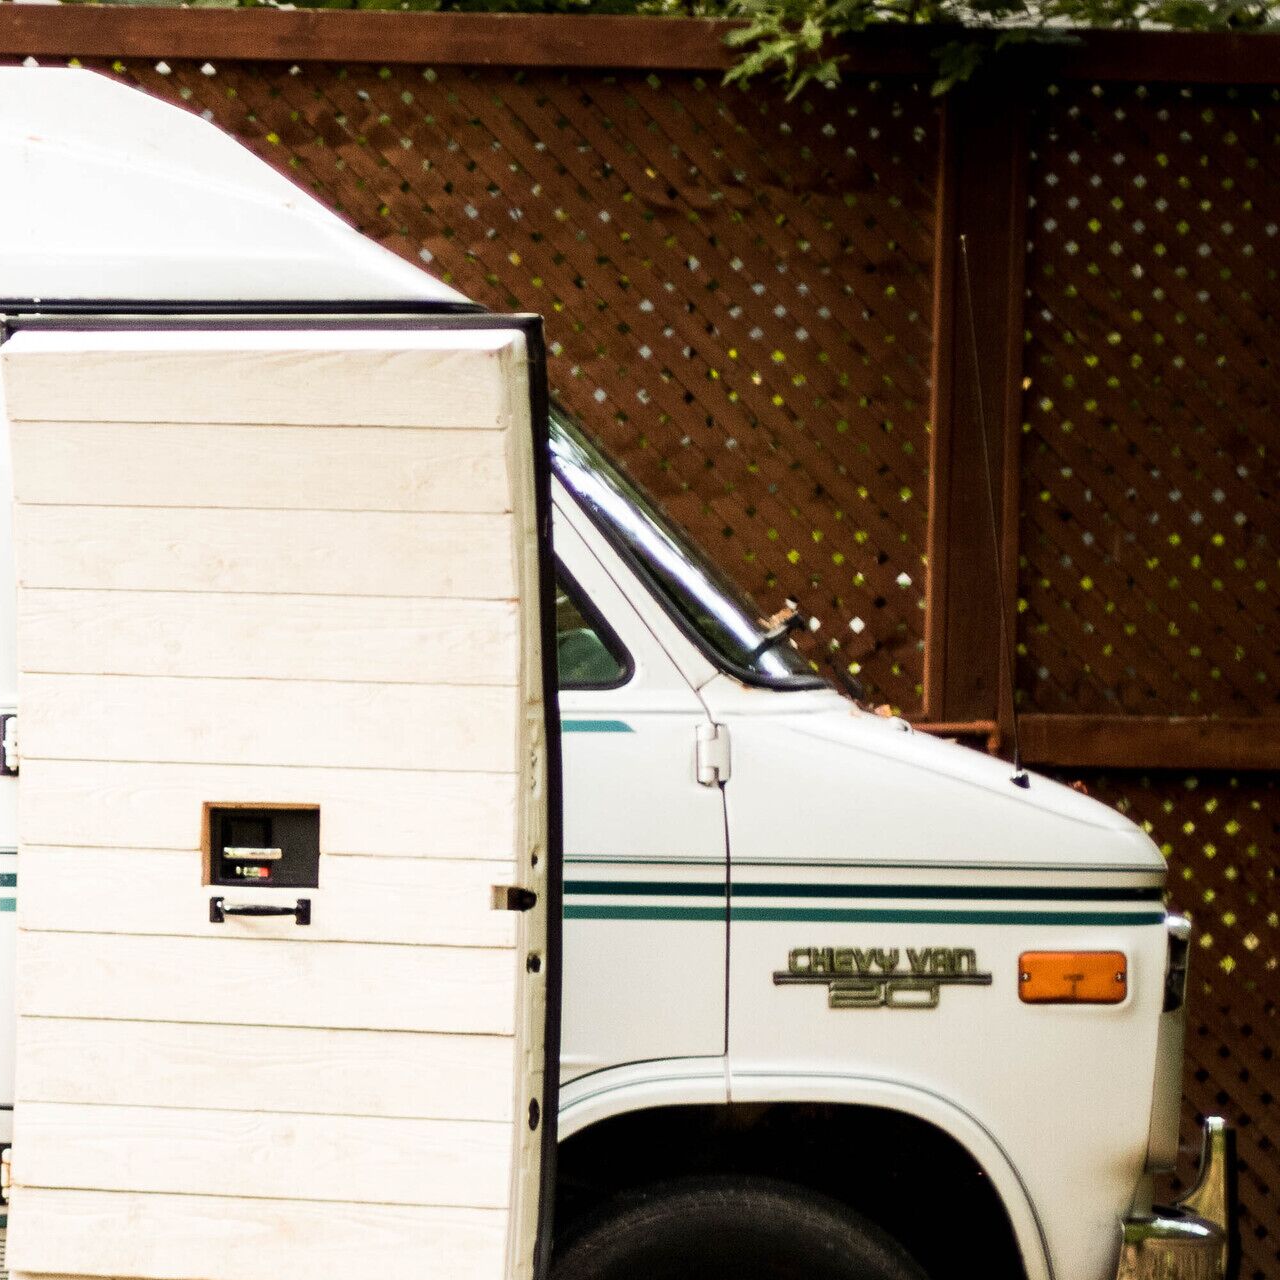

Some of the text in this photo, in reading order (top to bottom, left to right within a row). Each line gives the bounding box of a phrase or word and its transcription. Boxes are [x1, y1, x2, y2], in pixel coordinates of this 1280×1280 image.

[788, 947, 977, 973] CHEVY VAN
[828, 980, 940, 1009] 20
